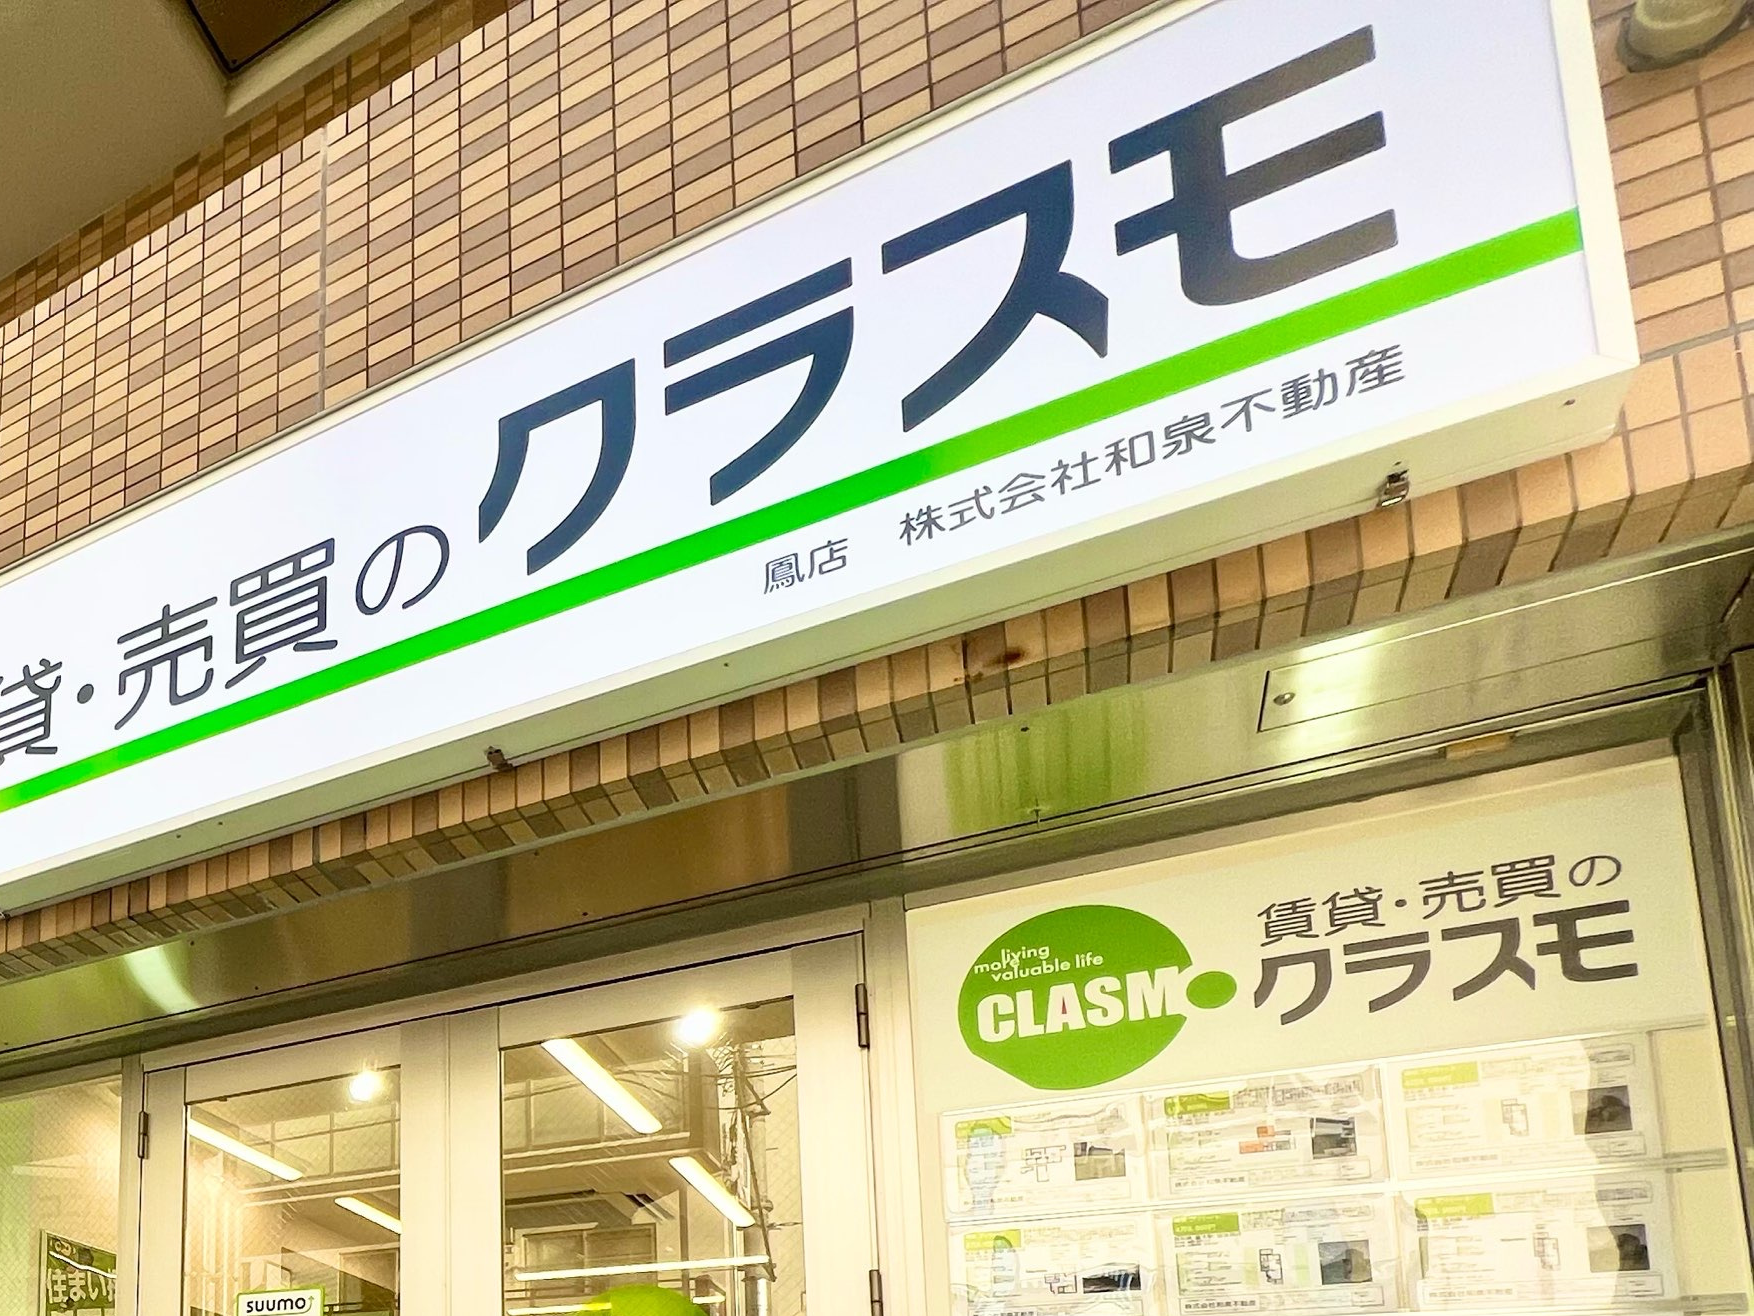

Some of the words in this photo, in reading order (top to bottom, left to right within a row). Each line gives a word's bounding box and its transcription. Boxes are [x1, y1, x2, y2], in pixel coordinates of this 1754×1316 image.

[762, 537, 850, 597] 鳳店
[897, 342, 1408, 548] 株式会社和泉不動産
[1258, 853, 1623, 947] 賃貸・売買の
[991, 959, 1071, 982] valuable
[1075, 951, 1104, 969] life
[1001, 946, 1050, 967] living
[1253, 899, 1639, 1026] クラスモ
